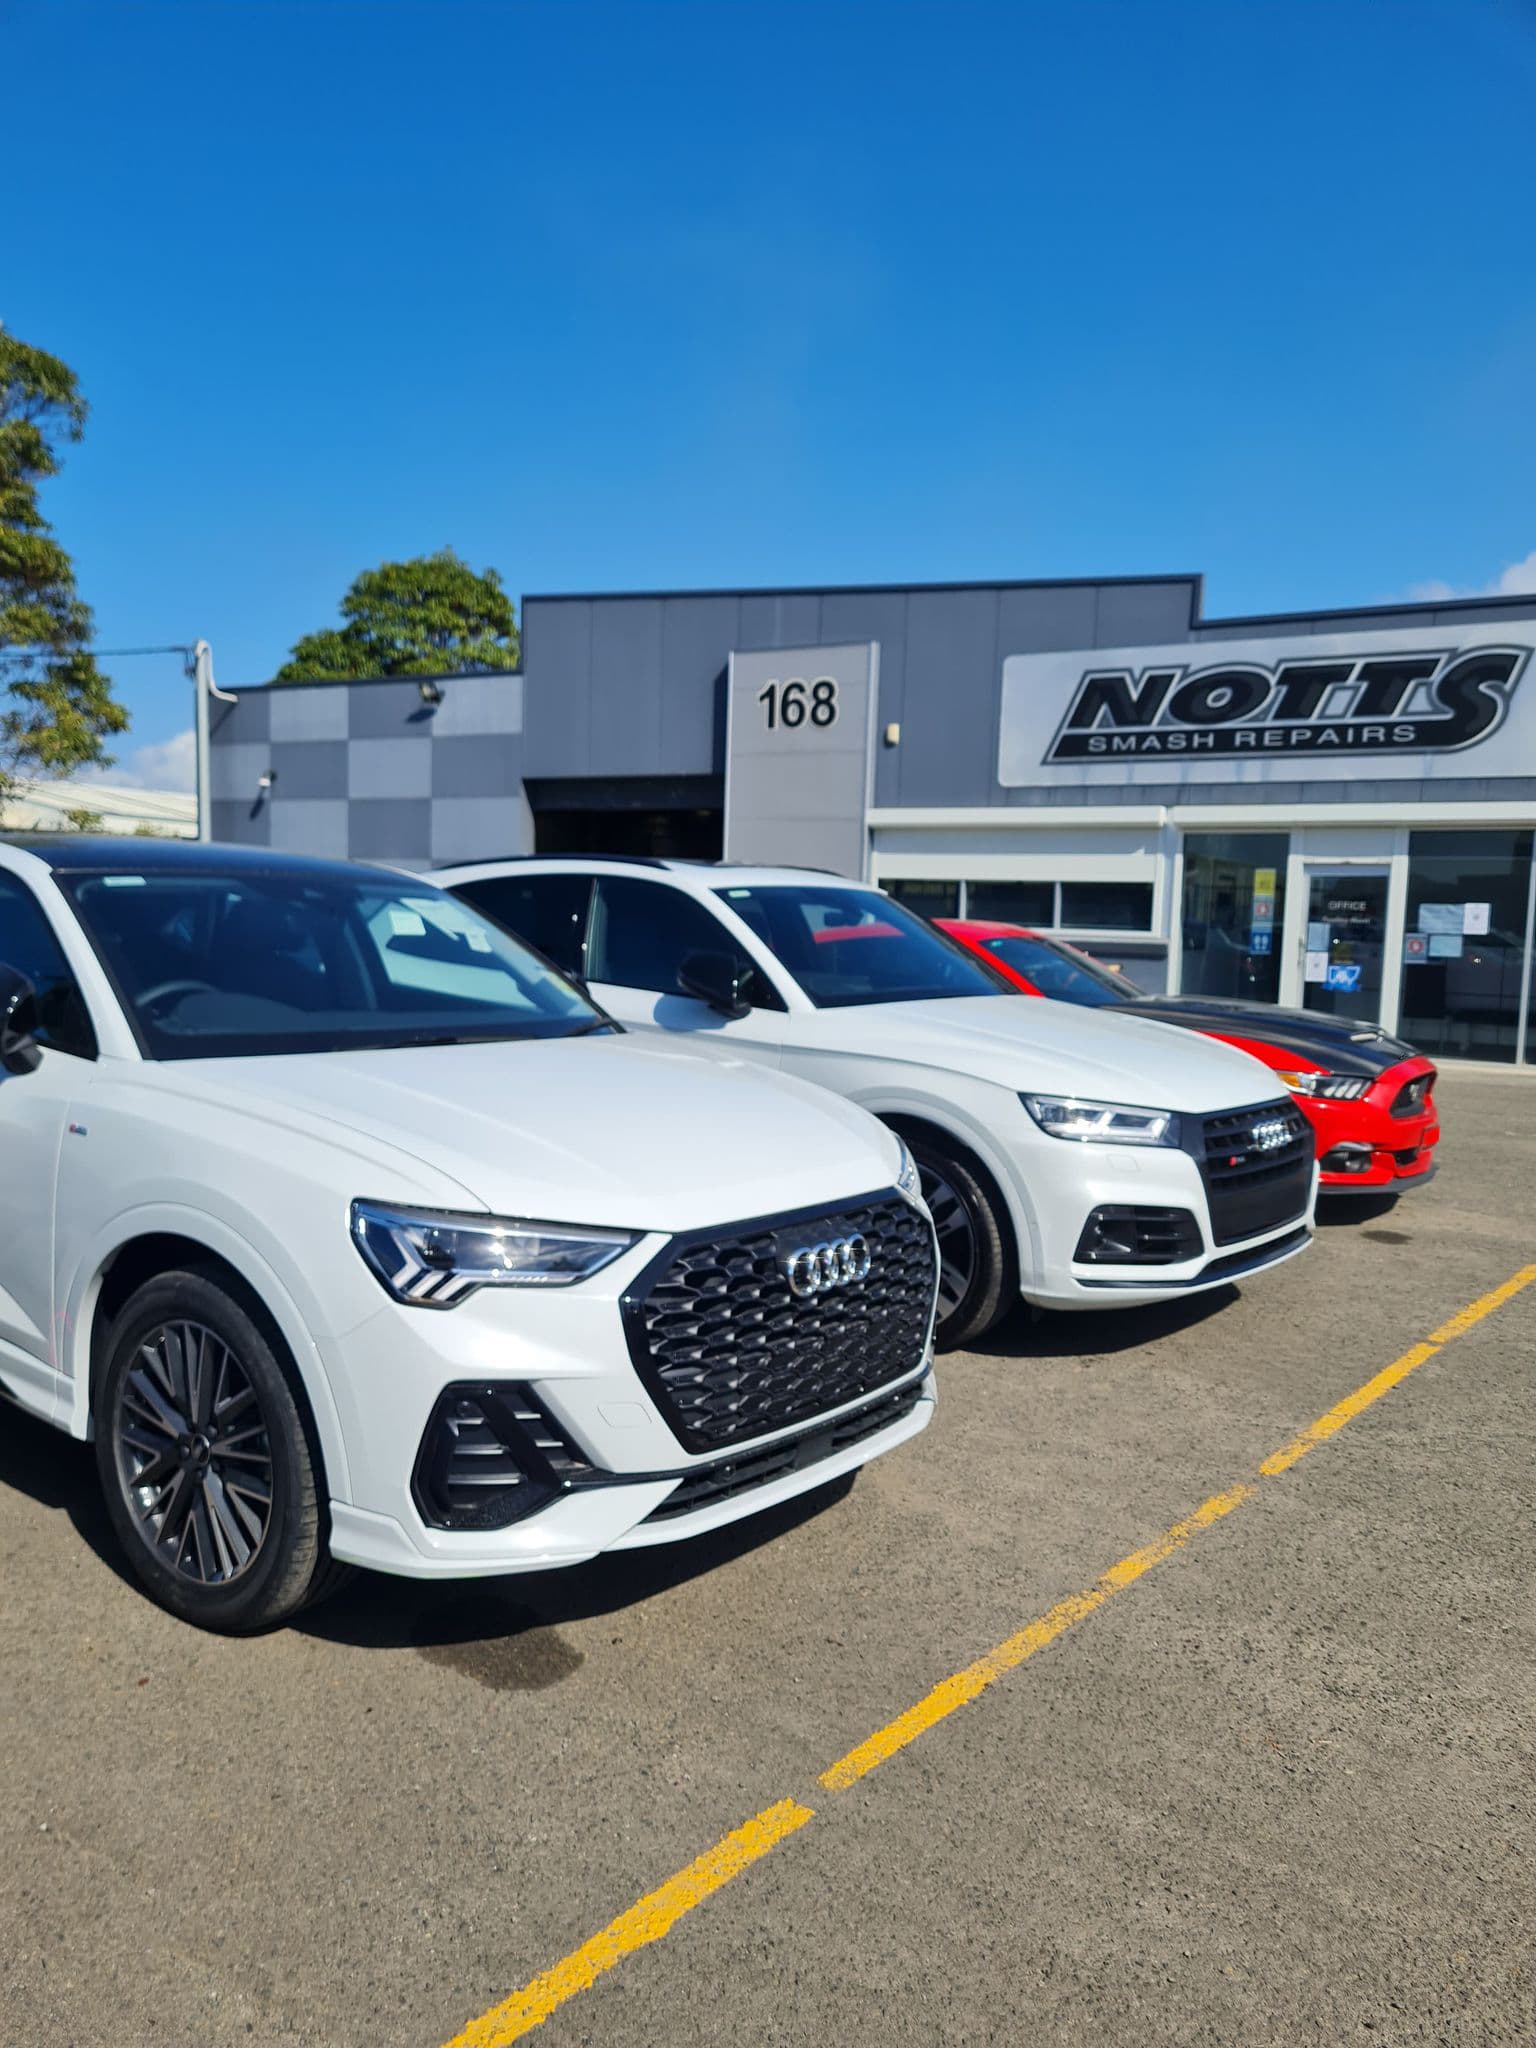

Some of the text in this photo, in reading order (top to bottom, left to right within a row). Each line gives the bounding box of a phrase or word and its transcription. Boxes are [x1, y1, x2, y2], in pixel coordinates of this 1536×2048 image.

[758, 680, 838, 730] 168
[1066, 652, 1522, 748] NOTTS
[1087, 725, 1417, 753] SMASH REPAIRS
[1328, 900, 1367, 911] OFFICE
